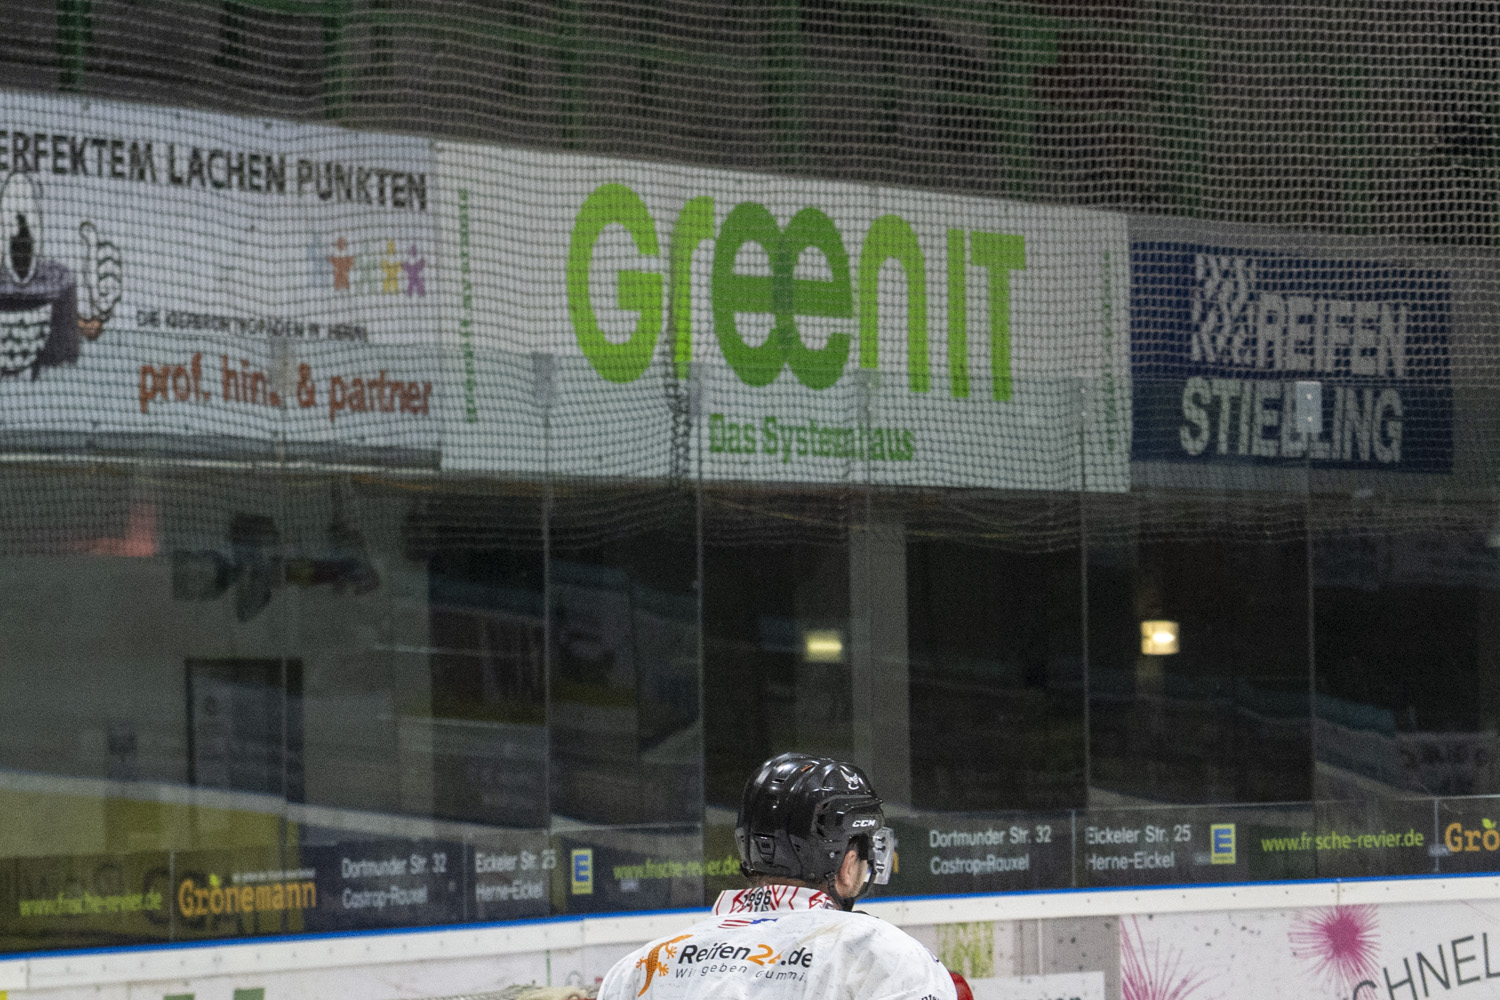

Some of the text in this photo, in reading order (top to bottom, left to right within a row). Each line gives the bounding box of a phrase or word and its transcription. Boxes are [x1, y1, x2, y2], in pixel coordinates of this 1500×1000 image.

[168, 142, 286, 193] LACHEN
[299, 159, 428, 210] PUNKTEN
[1256, 292, 1406, 377] REIFEN
[139, 352, 209, 414] prof.
[297, 362, 316, 409] &
[328, 369, 433, 423] partner
[709, 412, 916, 463] Das Systemhaus
[851, 818, 877, 829] CCM
[1085, 823, 1192, 846] Eickeler Str. 25
[929, 825, 1052, 849] Dortmunder Str. 32
[340, 856, 407, 879] Dortmunder
[432, 851, 447, 874] 32
[930, 853, 1030, 877] Castrop-Rauxel
[1085, 850, 1175, 872] Herne-Eickel
[742, 889, 772, 908] 1996
[700, 963, 748, 977] geben
